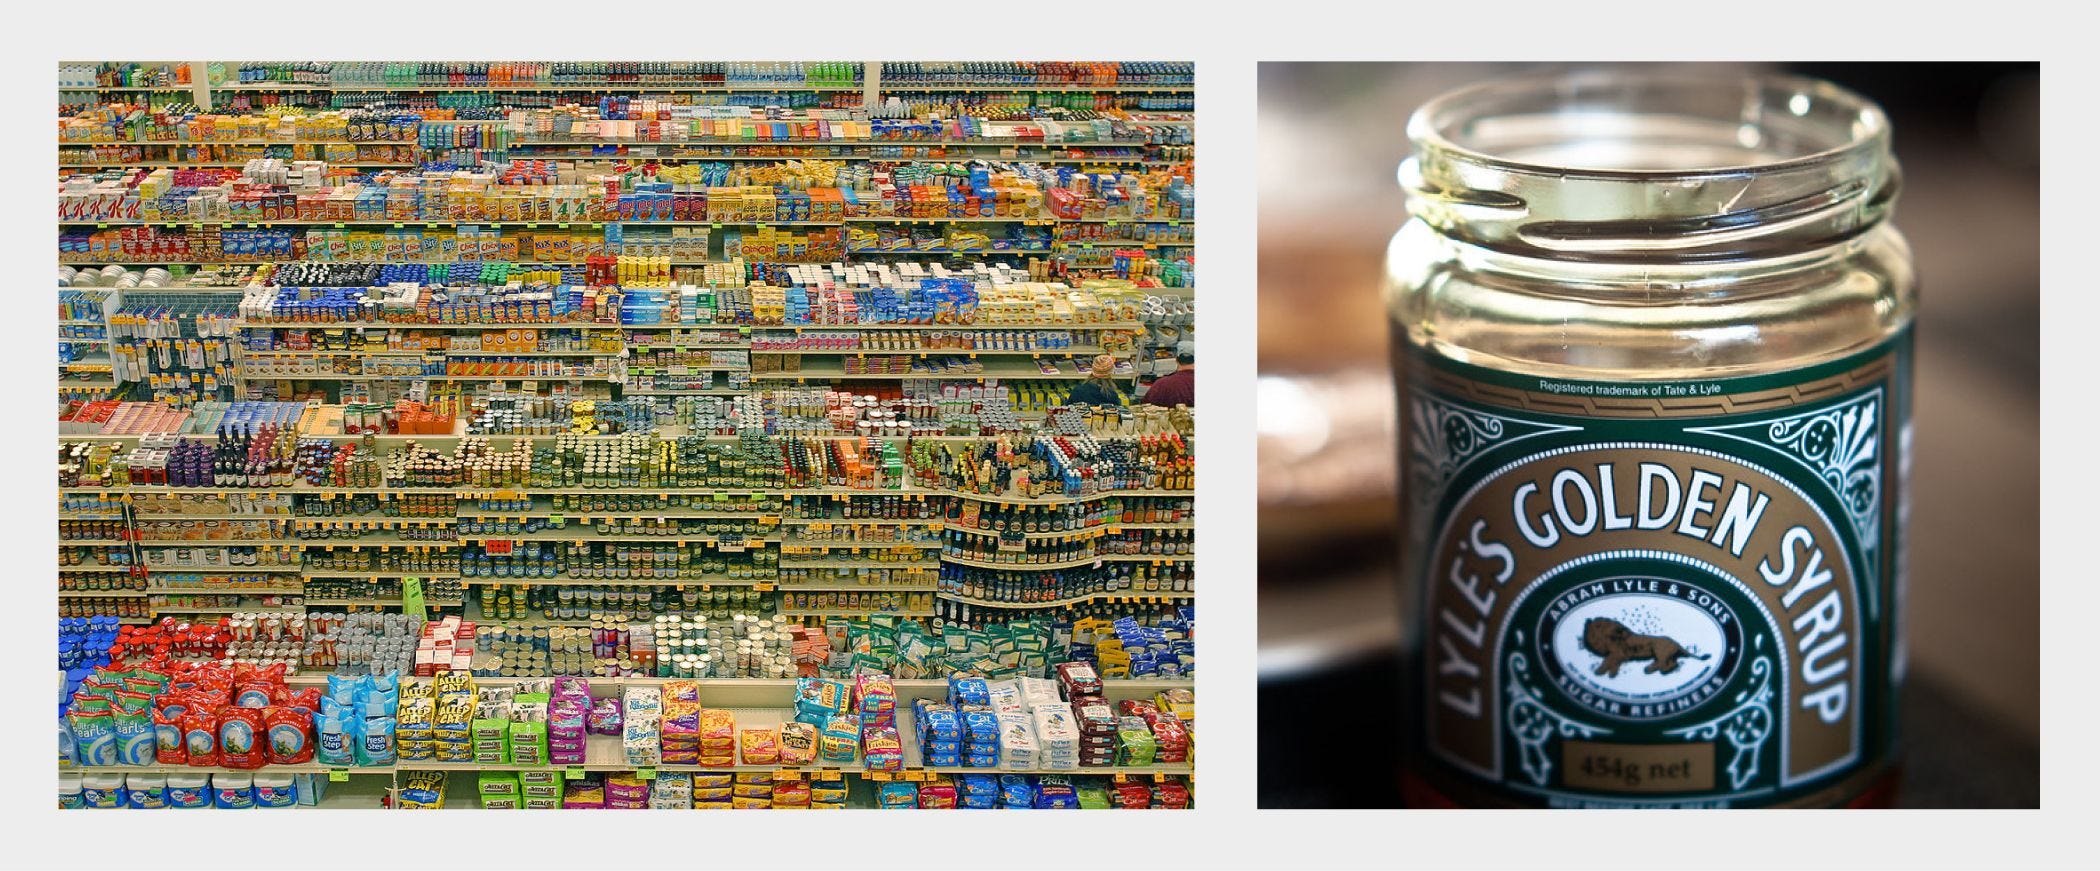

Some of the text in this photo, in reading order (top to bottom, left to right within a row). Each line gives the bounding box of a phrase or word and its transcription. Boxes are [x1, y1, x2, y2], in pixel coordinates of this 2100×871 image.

[74, 199, 87, 217] K
[90, 197, 102, 215] K
[108, 195, 125, 218] K
[126, 199, 141, 218] K
[558, 203, 569, 215] 4
[575, 203, 587, 215] 4
[308, 235, 324, 244] Chex
[330, 242, 346, 250] Chex
[1540, 380, 1722, 396] Registered trademark of Tate & Lyle
[1439, 461, 1850, 725] LYLE'S GOLDEN SYRUP
[1550, 580, 1731, 624] ABRAM LYLE & SONS
[438, 676, 467, 686] ALLEY
[958, 682, 984, 690] Cat
[401, 687, 432, 698] ALLEY
[442, 684, 464, 692] CAT
[1558, 674, 1621, 714] SUGAR
[1630, 676, 1725, 716] REFINERS
[400, 706, 430, 717] ALLEY
[440, 706, 471, 716] ALLEY
[928, 712, 954, 721] Cat
[402, 714, 425, 724] CAT
[440, 714, 461, 724] CAT
[968, 713, 990, 722] Cat
[322, 734, 342, 742] Fresh
[367, 736, 386, 744] Fresh
[868, 739, 900, 749] Friskies
[408, 770, 445, 782] ALLEY
[1581, 756, 1692, 786] 454g net
[409, 780, 434, 791] CAT
